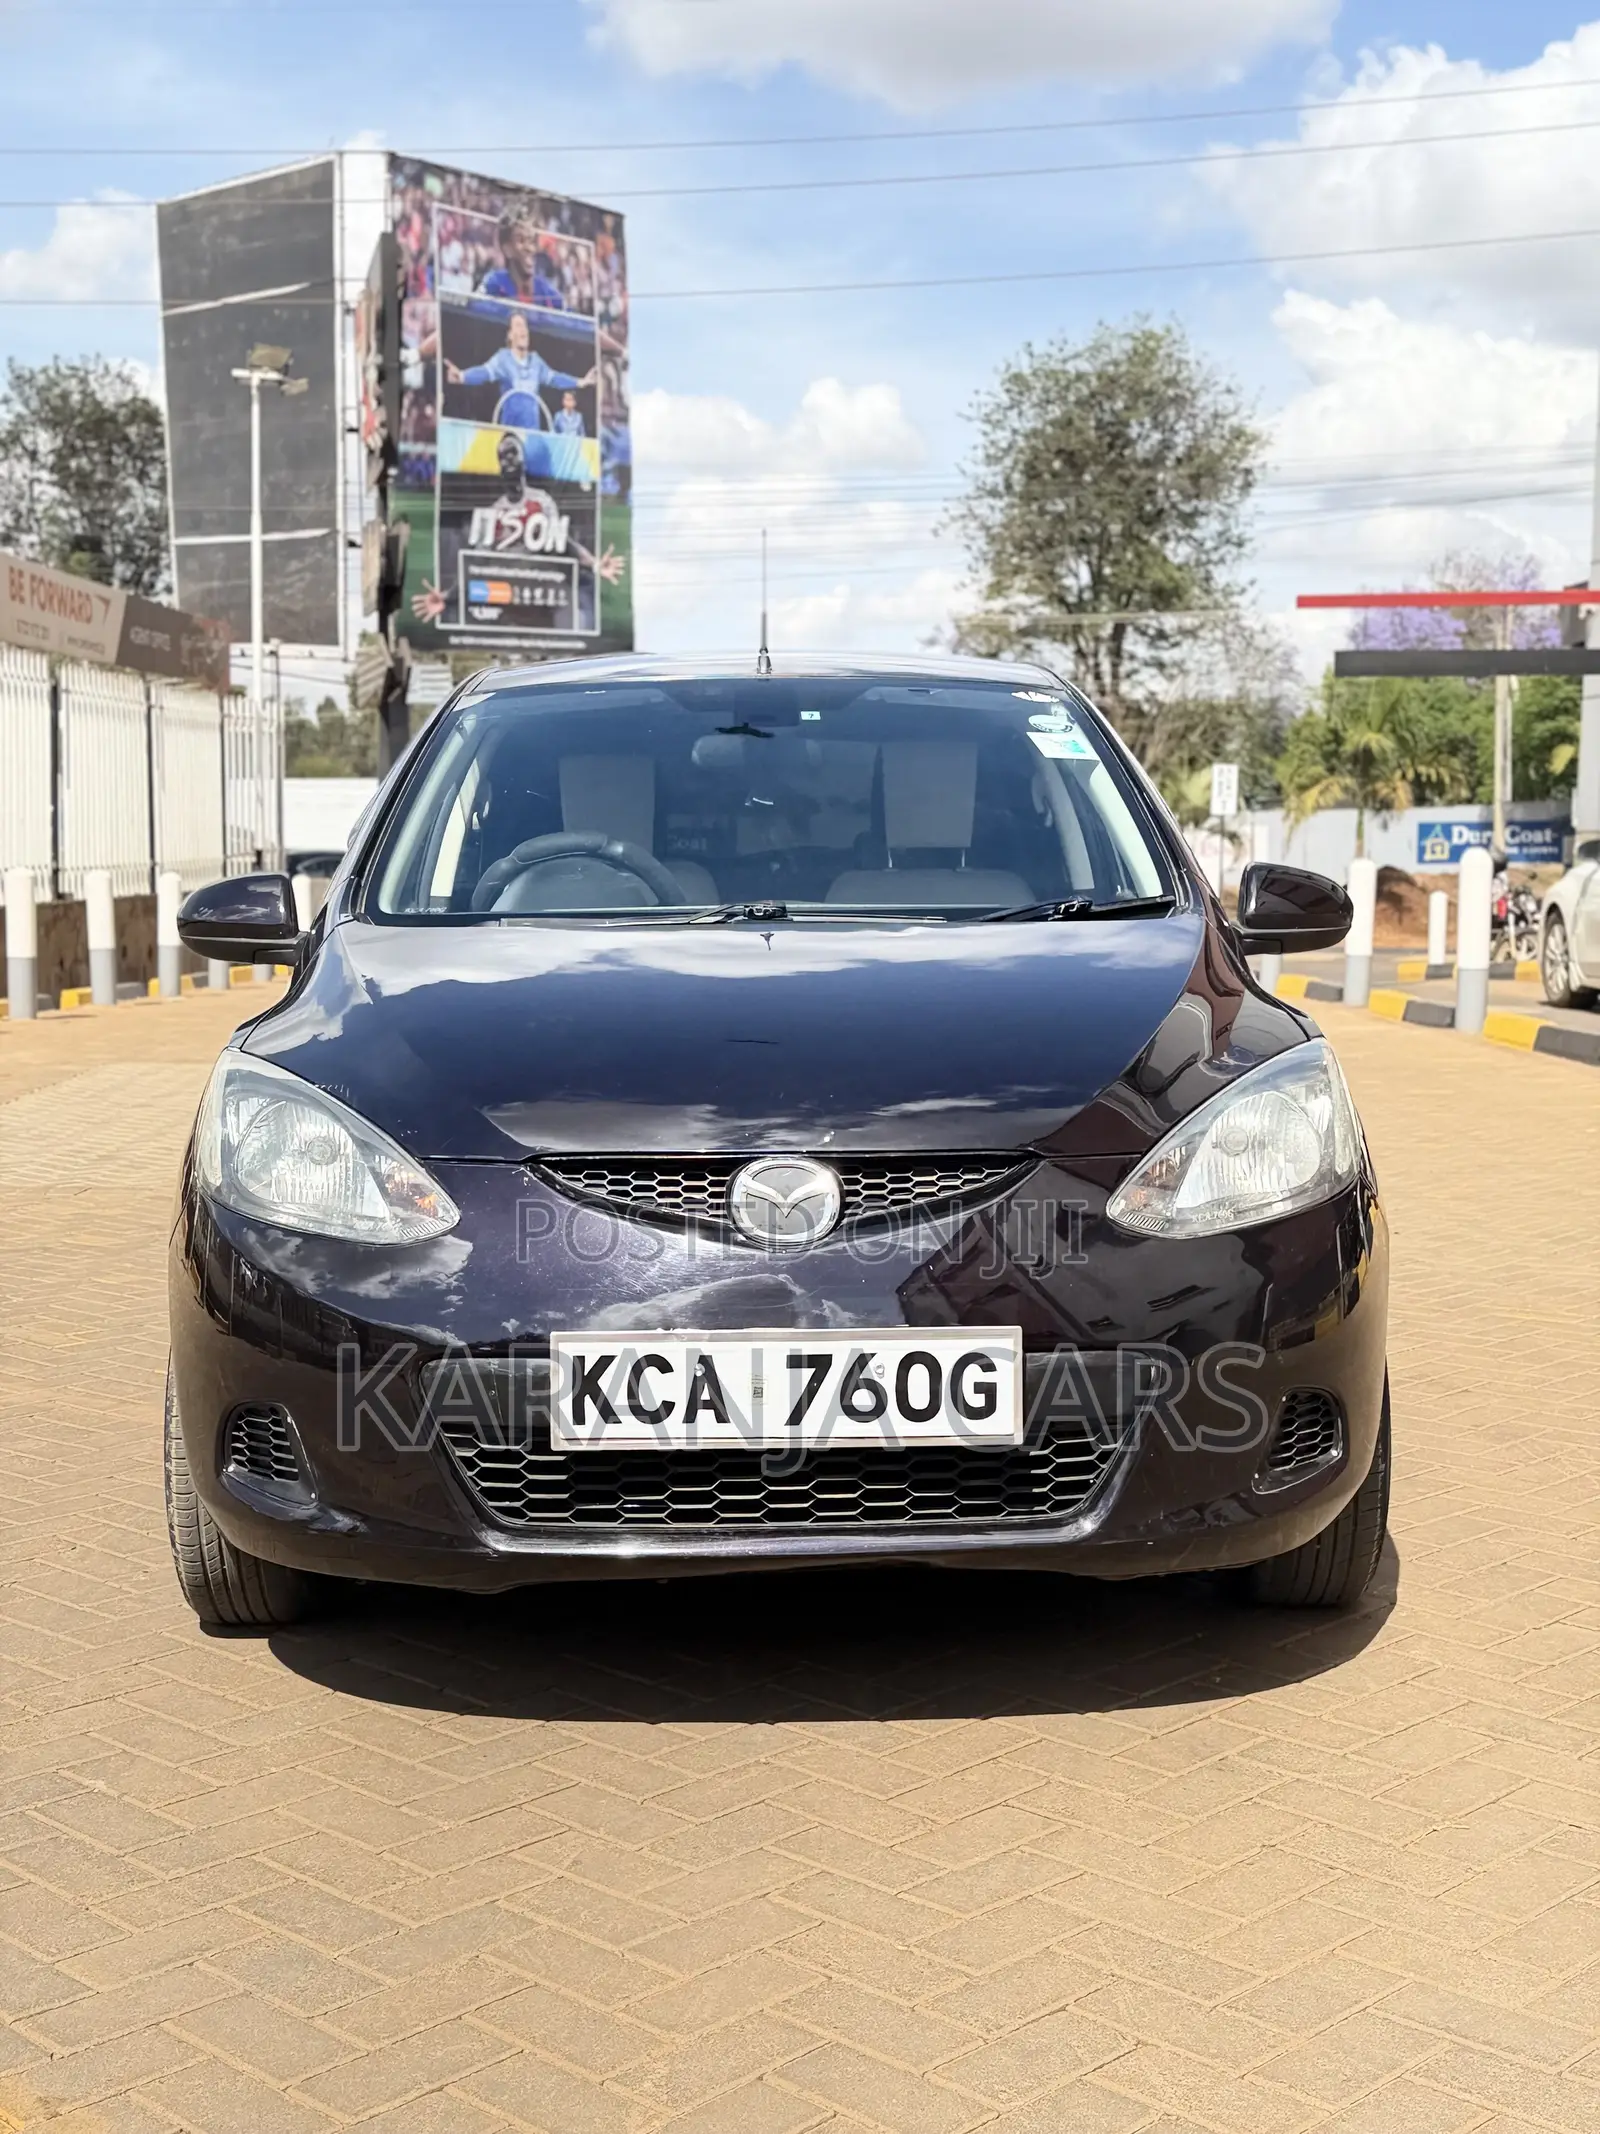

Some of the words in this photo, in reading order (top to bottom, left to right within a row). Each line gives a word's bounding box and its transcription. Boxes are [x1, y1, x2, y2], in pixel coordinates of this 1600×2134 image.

[524, 512, 570, 553] ON
[8, 566, 26, 606] BE
[29, 574, 94, 625] FORWARD
[571, 1353, 731, 1426] KCA
[784, 1351, 998, 1427] 760G
